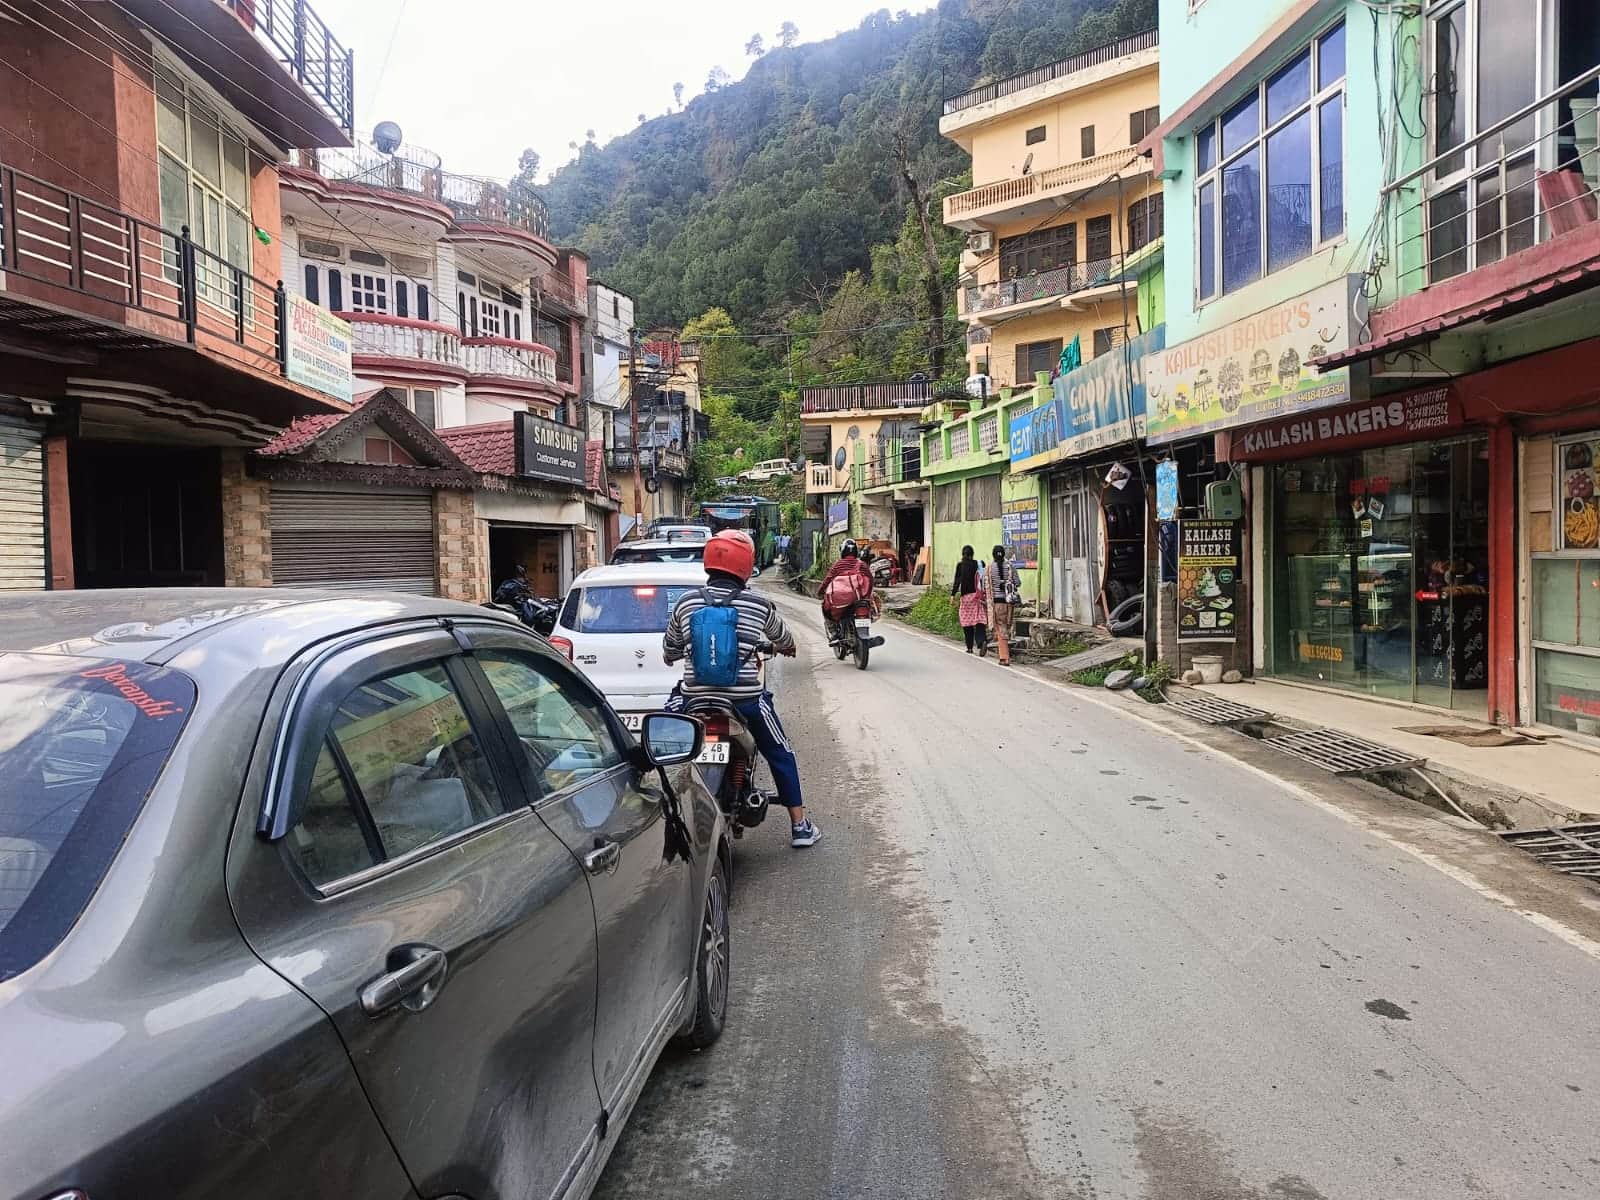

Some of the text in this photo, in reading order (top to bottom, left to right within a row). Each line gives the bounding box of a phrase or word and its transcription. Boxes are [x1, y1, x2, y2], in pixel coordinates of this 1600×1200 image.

[1165, 301, 1311, 375] KAILASH BAKER'S
[1244, 401, 1404, 454] KAILASH BAKERS
[534, 425, 578, 453] SAMSUNG
[536, 452, 577, 469] Customer Service
[1184, 529, 1232, 541] KAILASH
[1185, 543, 1231, 556] BAKER'S
